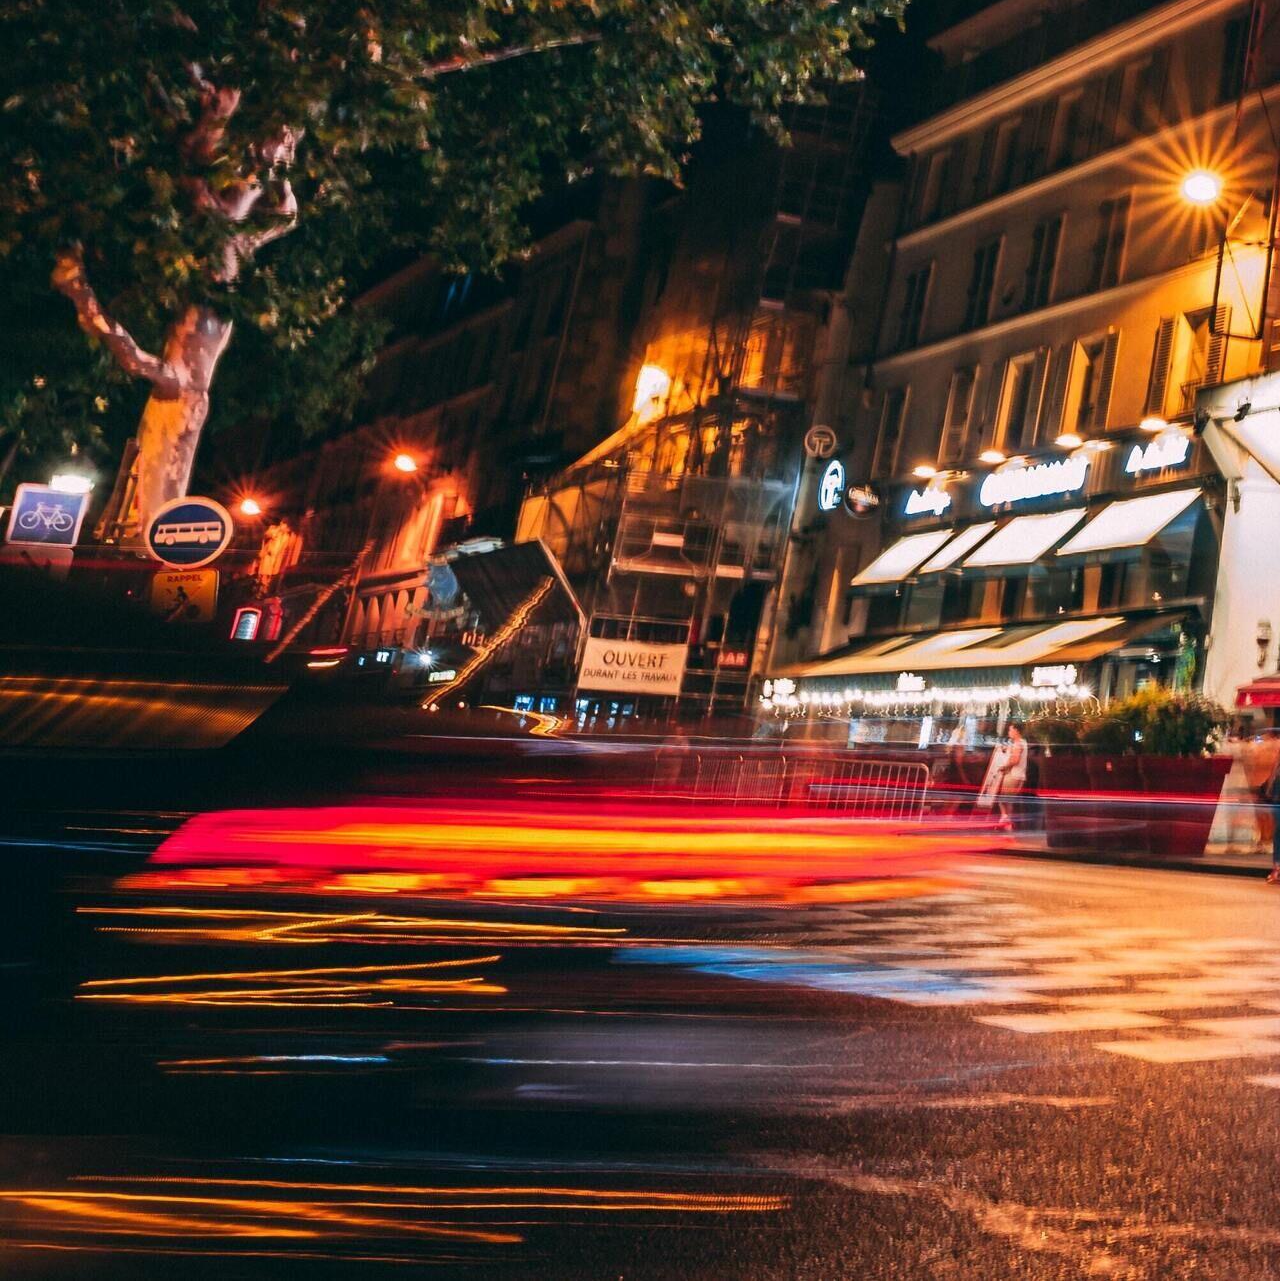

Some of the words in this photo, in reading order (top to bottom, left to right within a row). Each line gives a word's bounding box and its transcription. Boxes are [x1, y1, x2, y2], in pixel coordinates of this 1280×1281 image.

[167, 574, 203, 583] RAPPEL
[603, 649, 668, 669] OUVERT
[583, 668, 619, 679] DURANT
[622, 670, 638, 680] LES
[640, 672, 677, 683] TRAVAUX
